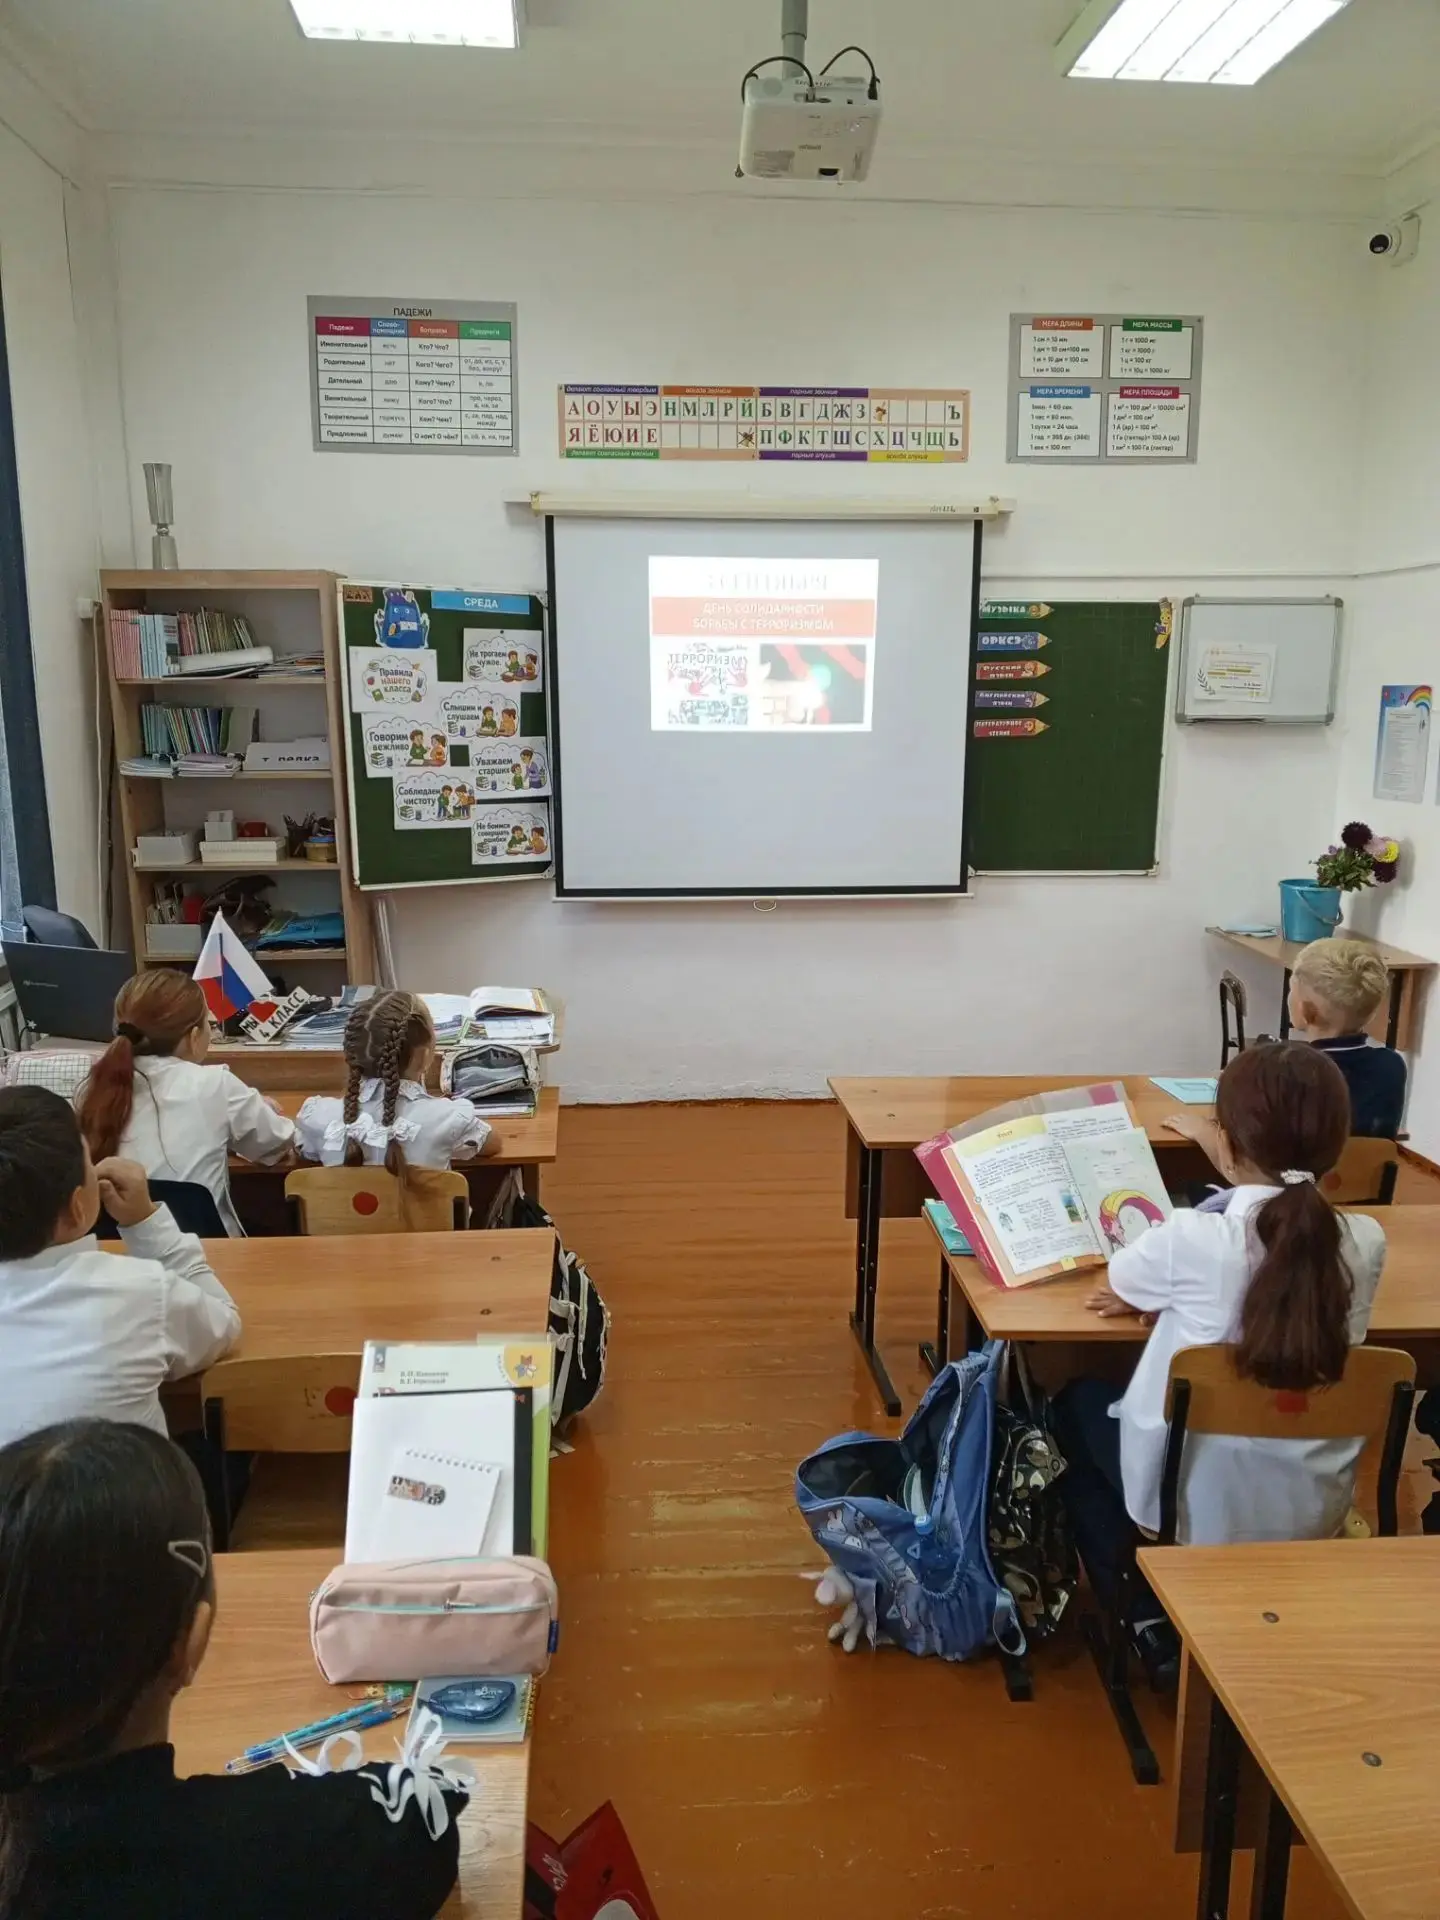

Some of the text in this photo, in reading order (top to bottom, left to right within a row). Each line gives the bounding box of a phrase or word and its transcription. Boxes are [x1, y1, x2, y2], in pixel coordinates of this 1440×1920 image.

[393, 307, 432, 317] ПАДЕЖИ
[329, 323, 354, 331] Падежи
[1059, 320, 1084, 328] ДЛИНЫ
[323, 358, 365, 366] Родительный
[568, 398, 960, 421] А О У Ы Э Н М Л Р Й Б В Г Д Ж З Ъ
[569, 424, 959, 450] Я Ё Ю И Е П Ф К Т Ш С Х Ц Ч Щ Ь
[464, 597, 499, 609] СРЕДА
[702, 602, 824, 615] ДЕНЬ СОЛИДАРНОСТИ
[982, 605, 1026, 613] МУЗЫКА
[693, 617, 738, 629] БОРЬБЫ
[750, 617, 834, 630] ТЕРРОРИЗМОМ
[982, 635, 1022, 645] ОРКСЭ
[469, 650, 507, 659] Не трогаем
[379, 667, 414, 678] Правила
[381, 676, 411, 686] нашего
[383, 685, 412, 694] класса
[443, 702, 477, 712] Слышим
[447, 712, 480, 722] слушаем
[369, 731, 409, 743] Говорим
[372, 743, 410, 751] вежливо
[475, 757, 513, 767] Уважаем
[478, 767, 510, 776] старших
[398, 786, 441, 797] Соблюдаем
[403, 797, 436, 807] чистоту
[476, 822, 511, 831] Не боимся
[258, 992, 304, 1038] 4 КЛАСС
[241, 1016, 259, 1034] МЫ
